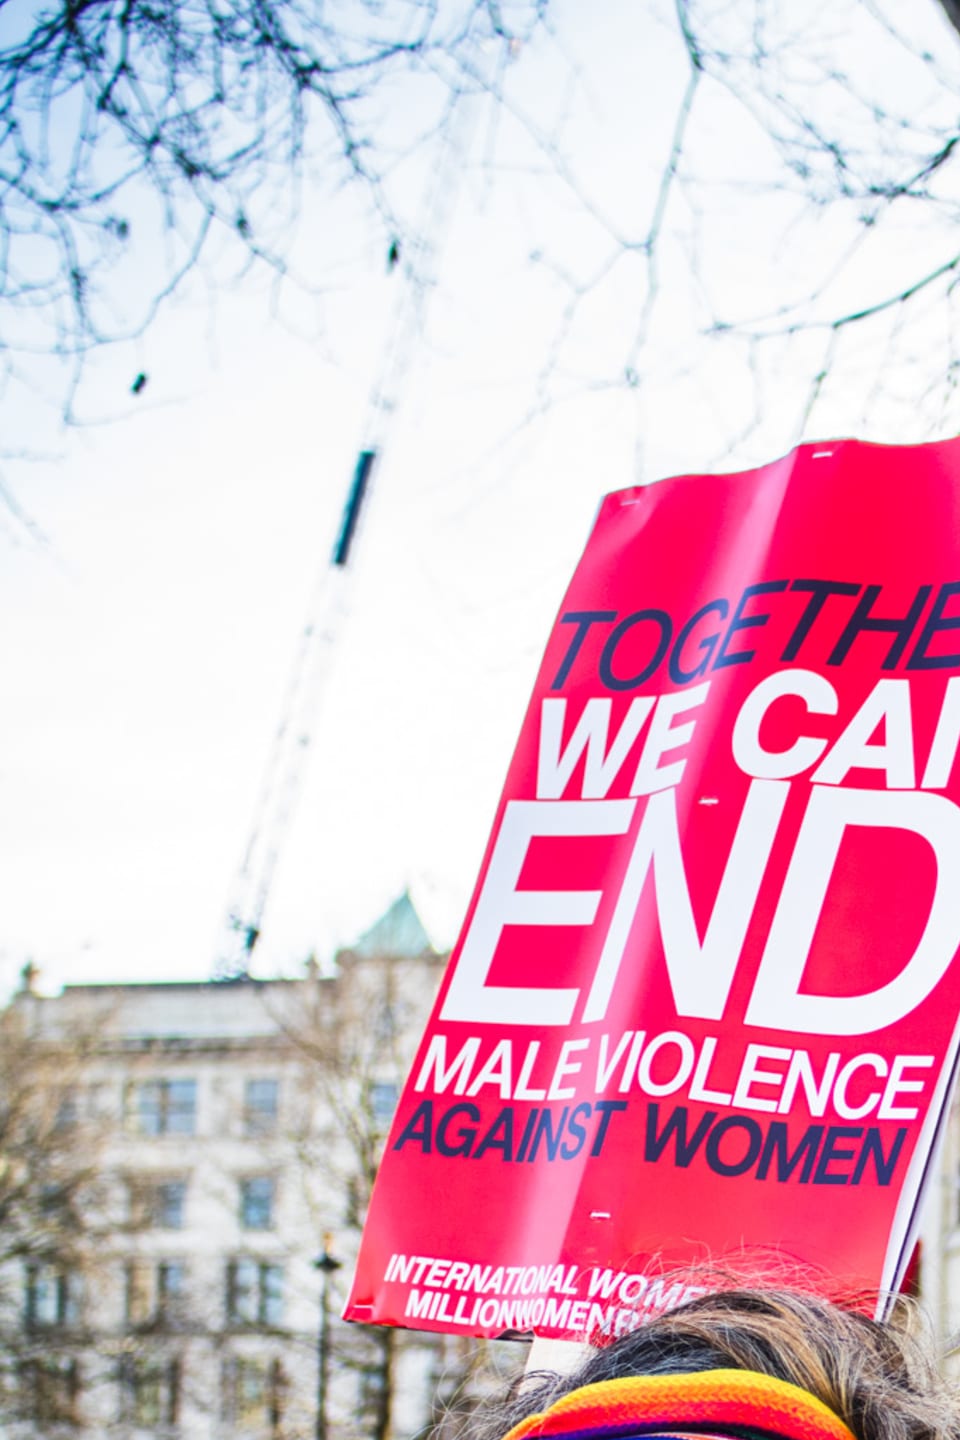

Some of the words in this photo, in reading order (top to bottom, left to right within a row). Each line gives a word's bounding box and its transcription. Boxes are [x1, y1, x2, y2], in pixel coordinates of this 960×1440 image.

[536, 682, 711, 799] WE
[415, 1034, 590, 1101] MALE
[595, 1030, 934, 1119] VIOLENCE
[393, 1100, 626, 1163] AGAINST
[644, 1103, 908, 1187] WOMEN
[384, 1254, 578, 1295] INTERNATIONAL
[588, 1268, 716, 1311] WOME
[404, 1290, 652, 1338] MILLIONWOMENR
